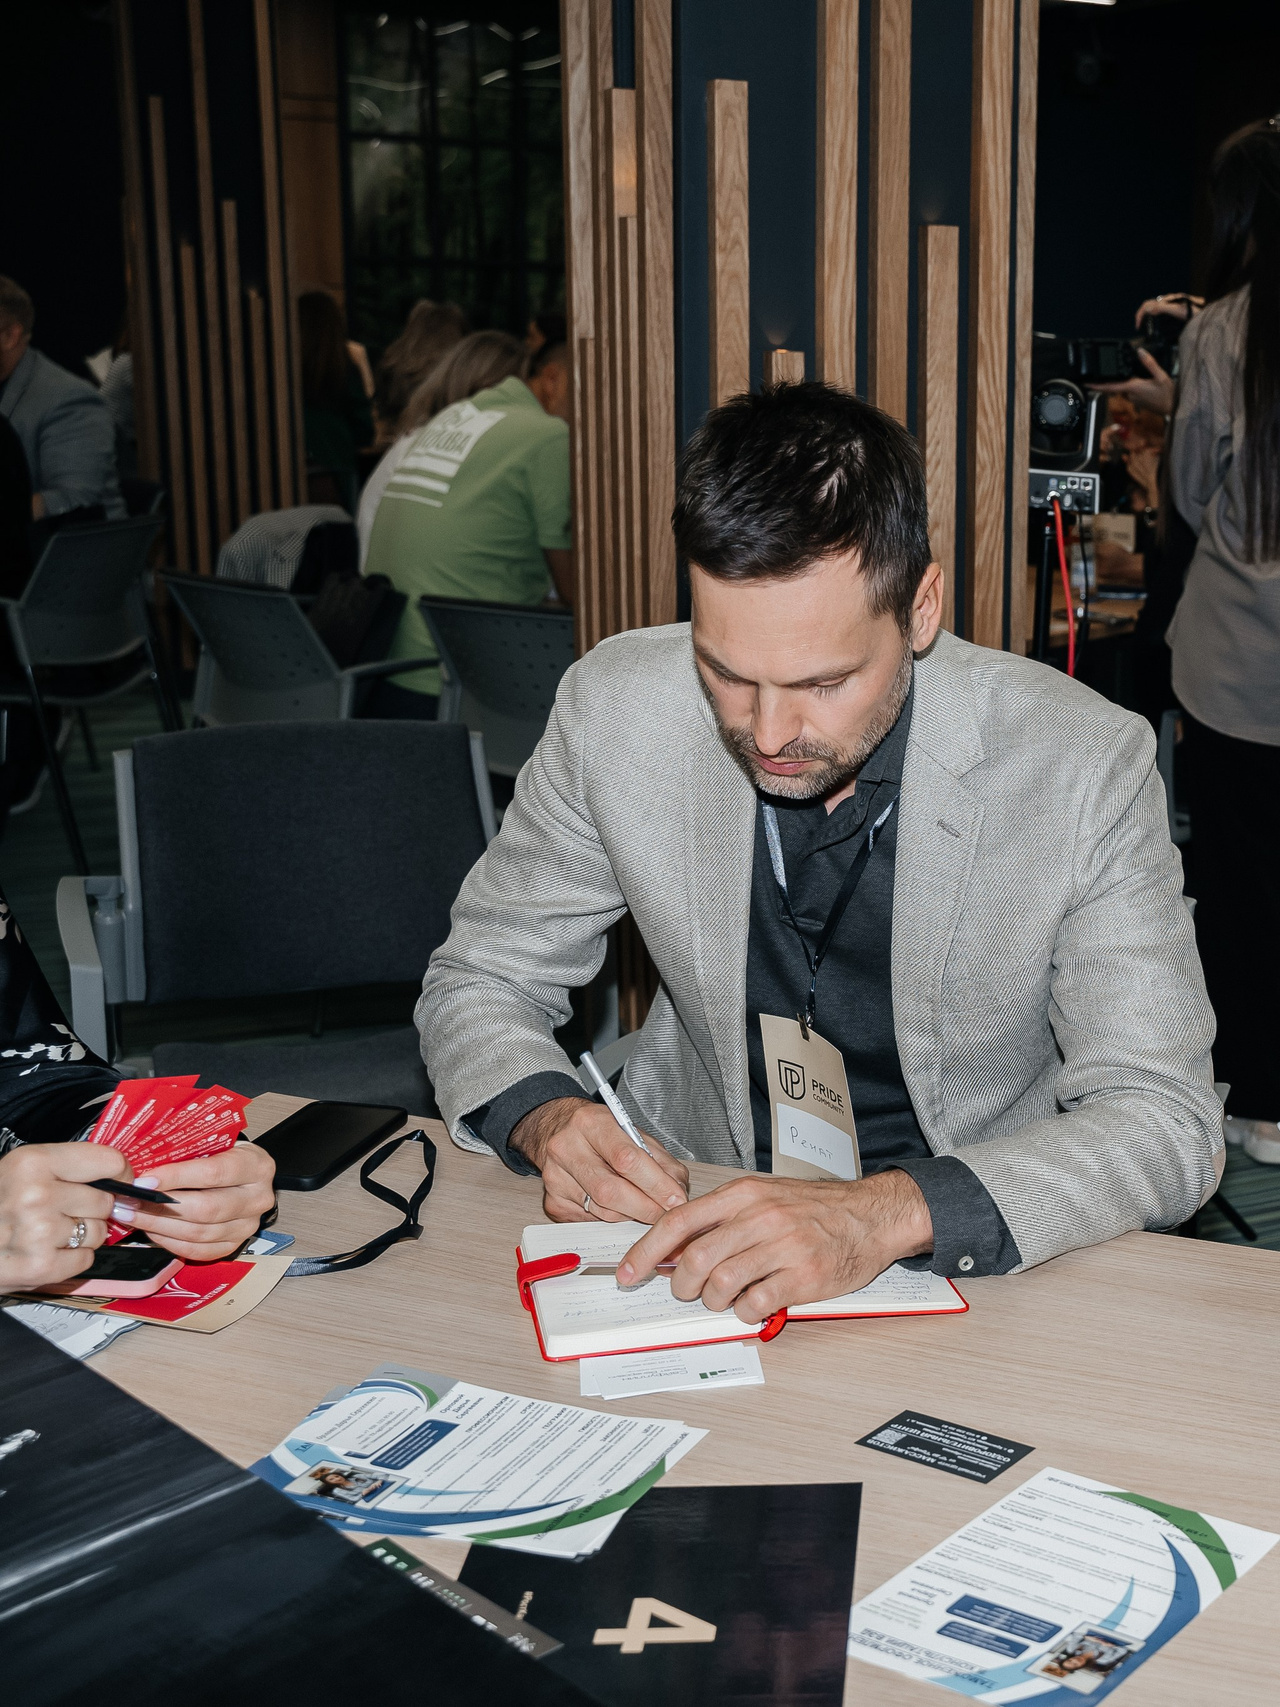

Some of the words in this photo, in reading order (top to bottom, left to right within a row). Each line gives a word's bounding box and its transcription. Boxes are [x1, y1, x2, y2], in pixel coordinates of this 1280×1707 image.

[812, 1079, 844, 1107] PRIDE
[813, 1094, 845, 1116] COMMUNITY
[185, 1294, 203, 1310] VERA
[201, 1283, 229, 1302] VETKINA
[440, 1393, 465, 1414] Орловой
[465, 1395, 510, 1434] ПРОФЕССИОНАЛИЗМ
[520, 1401, 536, 1415] СРОКИ
[542, 1407, 567, 1430] ГЕОГРАФИЯ
[578, 1415, 601, 1433] ГИБКОСТЬ
[642, 1424, 655, 1434] ЦЕНА
[891, 1423, 920, 1436] ЦЕНТР
[600, 1419, 628, 1442] ЗАКОННОСТЬ
[866, 1438, 936, 1463] МАССАЖИСТОВ
[920, 1431, 1011, 1463] ОЗДОРОВИТЕЛЬНЫЙ
[592, 1596, 718, 1655] 4
[861, 1628, 882, 1641] ВЭД
[885, 1636, 975, 1672] КОНСУЛЬТАЦИИ
[915, 1657, 998, 1689] ТАМОЖЕННОЕ
